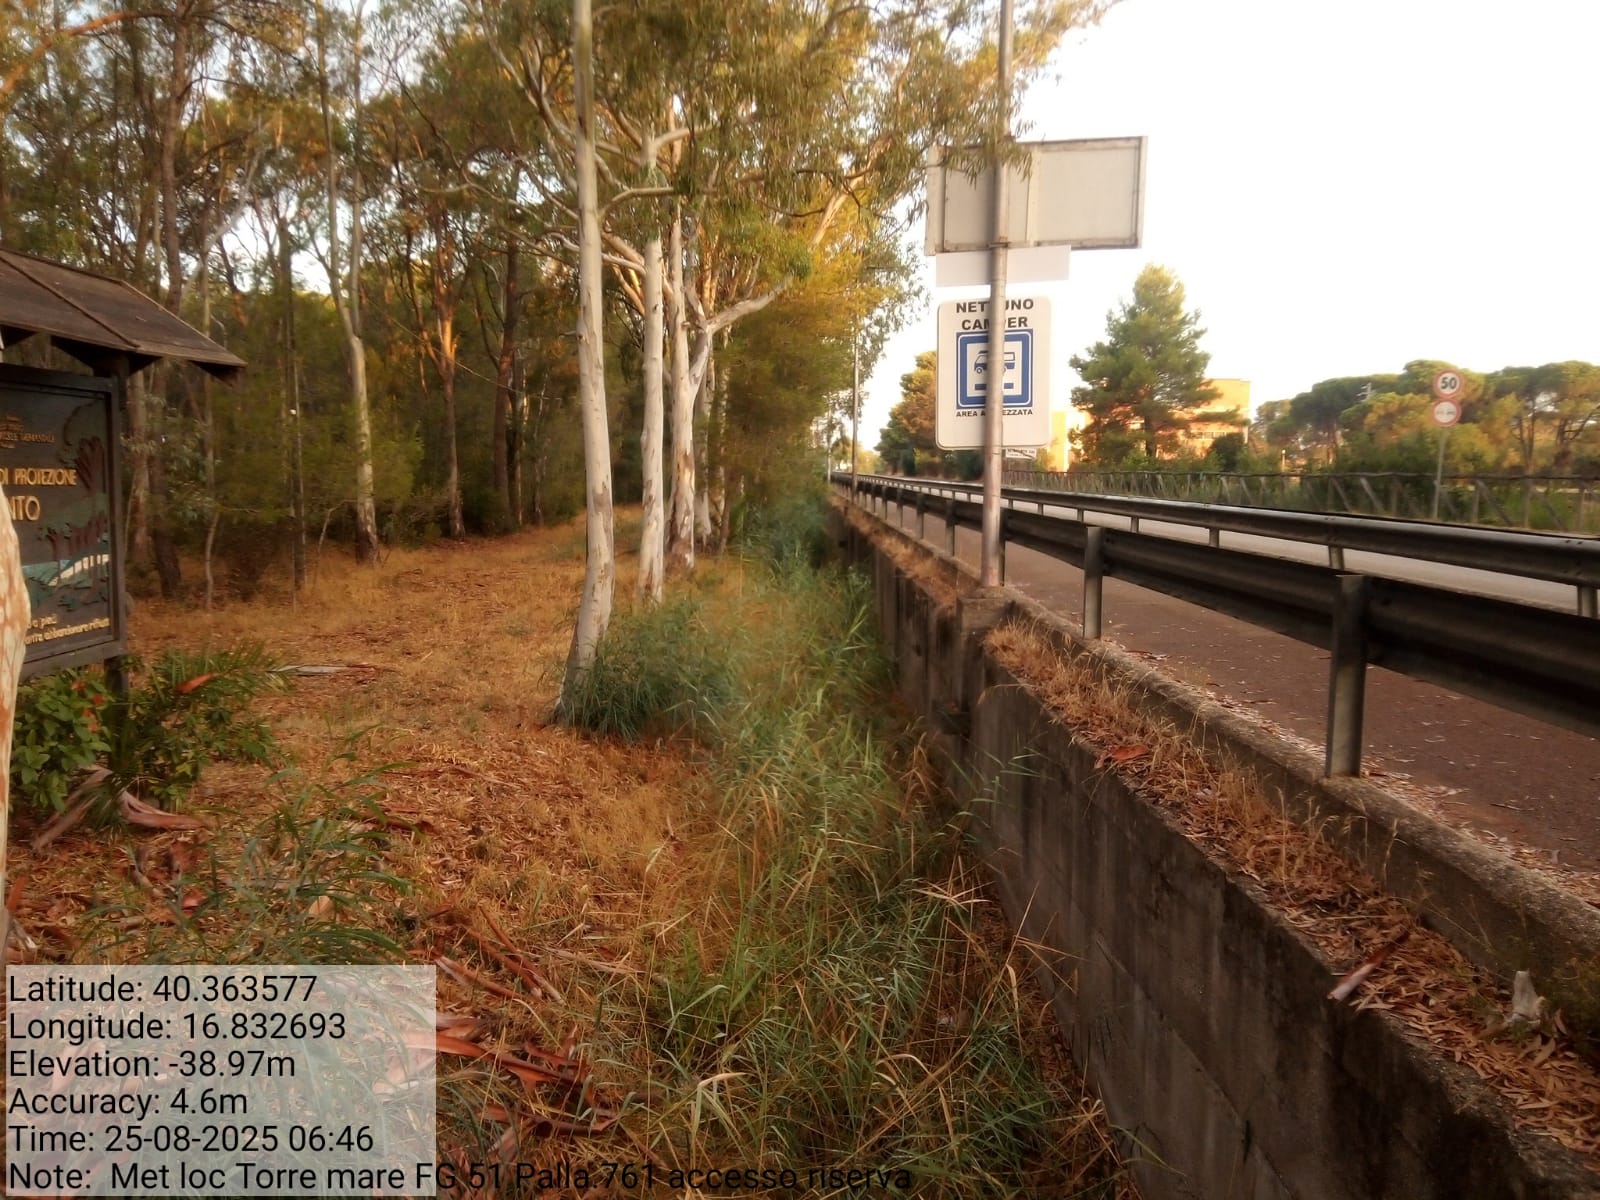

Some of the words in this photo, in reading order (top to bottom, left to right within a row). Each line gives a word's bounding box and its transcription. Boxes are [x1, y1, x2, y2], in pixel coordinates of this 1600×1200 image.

[956, 298, 1034, 313] NETNO
[961, 316, 1028, 330] CAER
[1440, 376, 1457, 390] 50
[14, 467, 77, 486] PROTEZIONE
